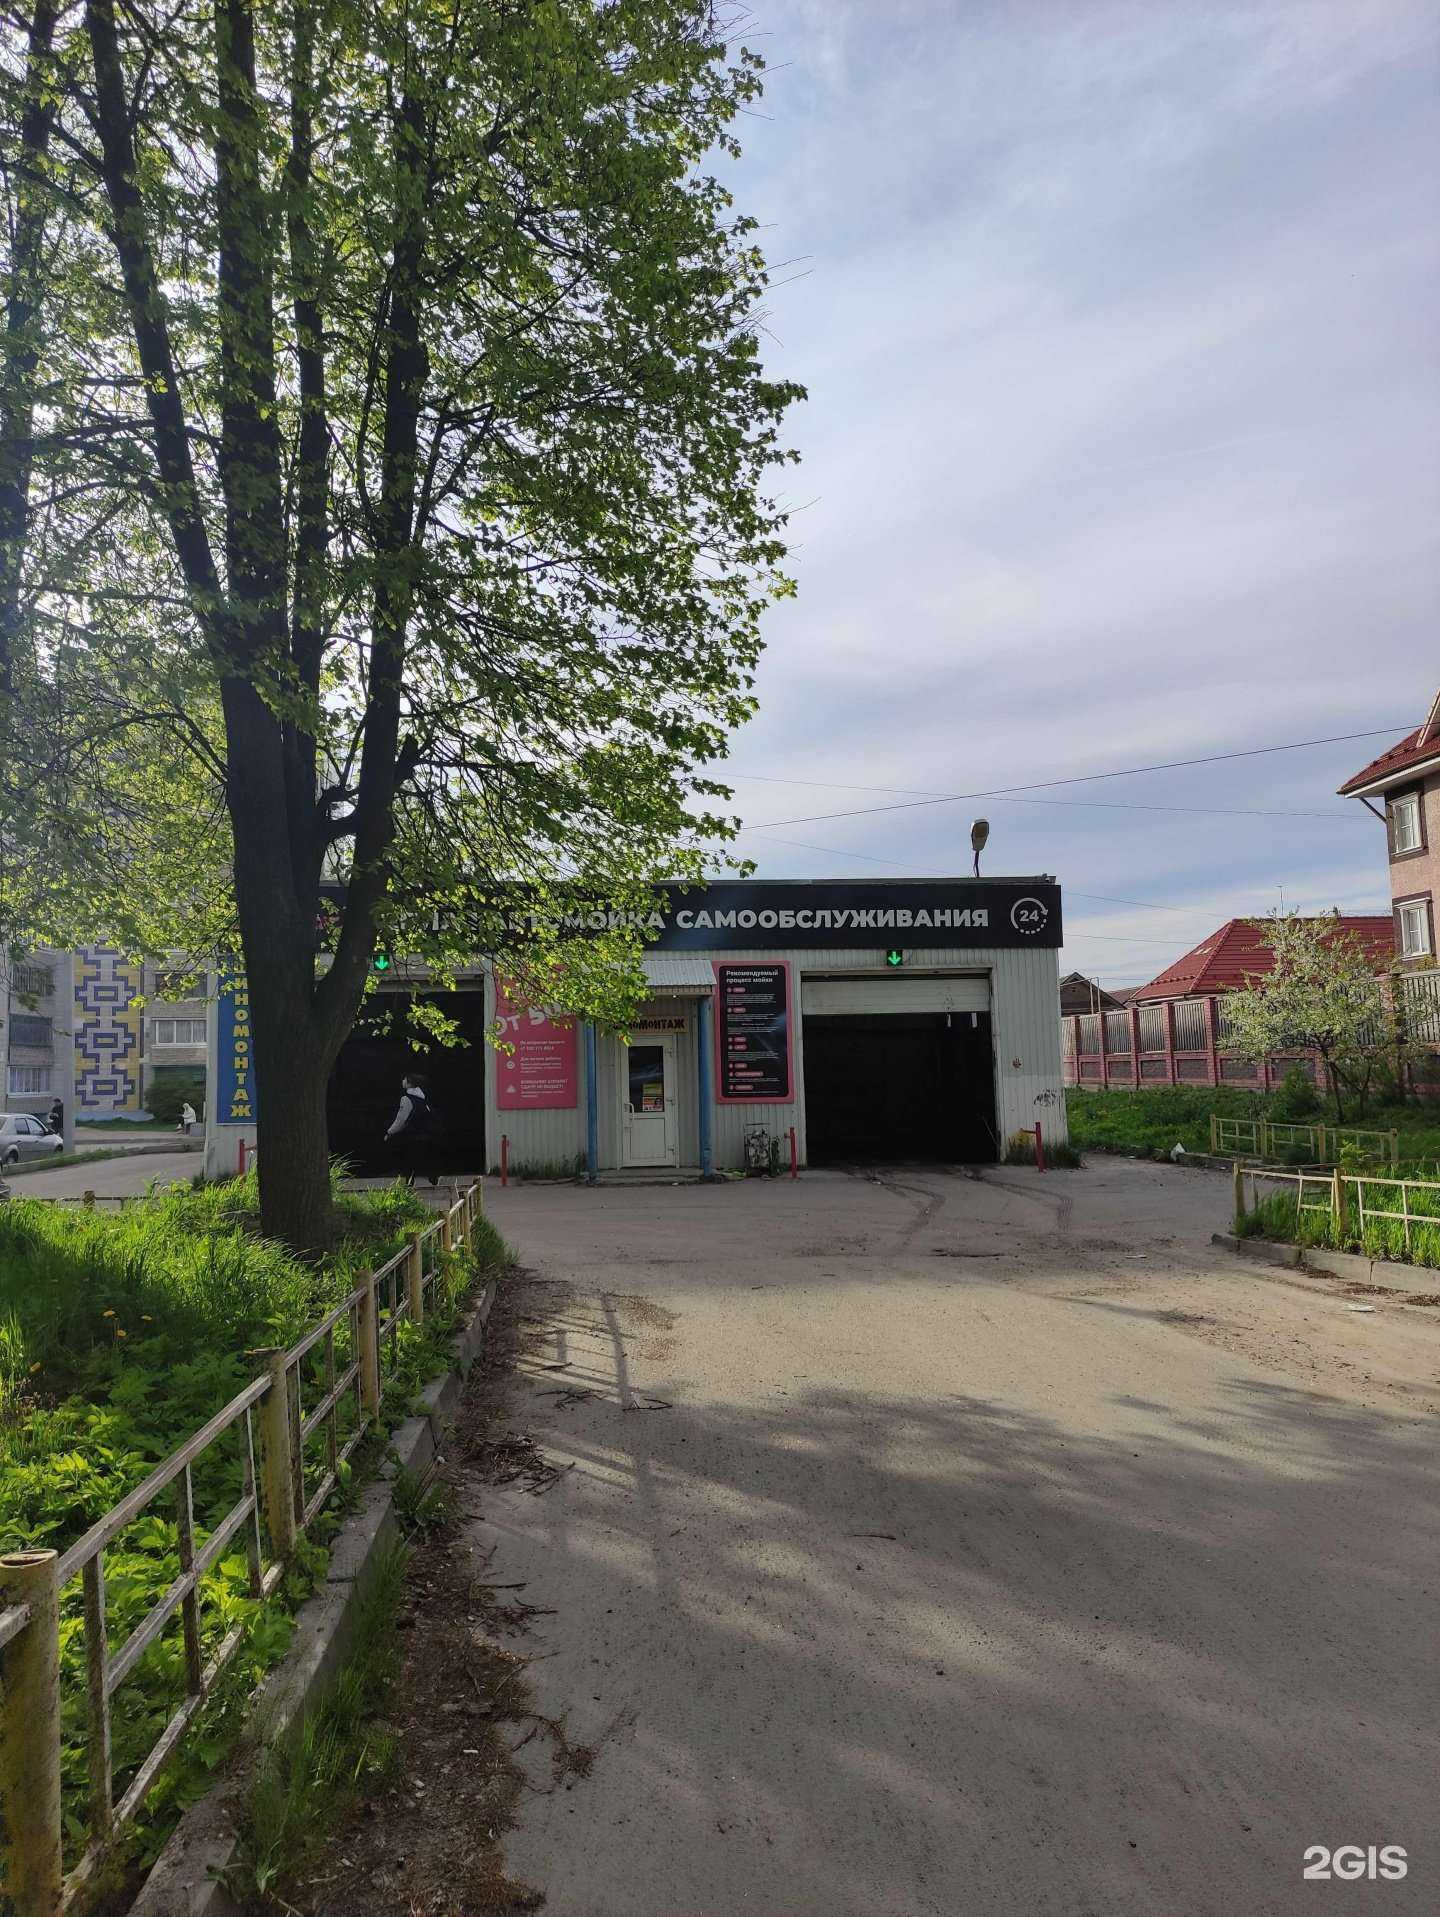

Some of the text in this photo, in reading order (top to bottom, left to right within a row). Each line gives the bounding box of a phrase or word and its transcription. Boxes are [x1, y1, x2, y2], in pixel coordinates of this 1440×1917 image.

[676, 908, 989, 929] САМООБСЛУЖИВАНИЯ
[1020, 910, 1040, 922] 24
[611, 1018, 686, 1030] ОМОНТАЖ
